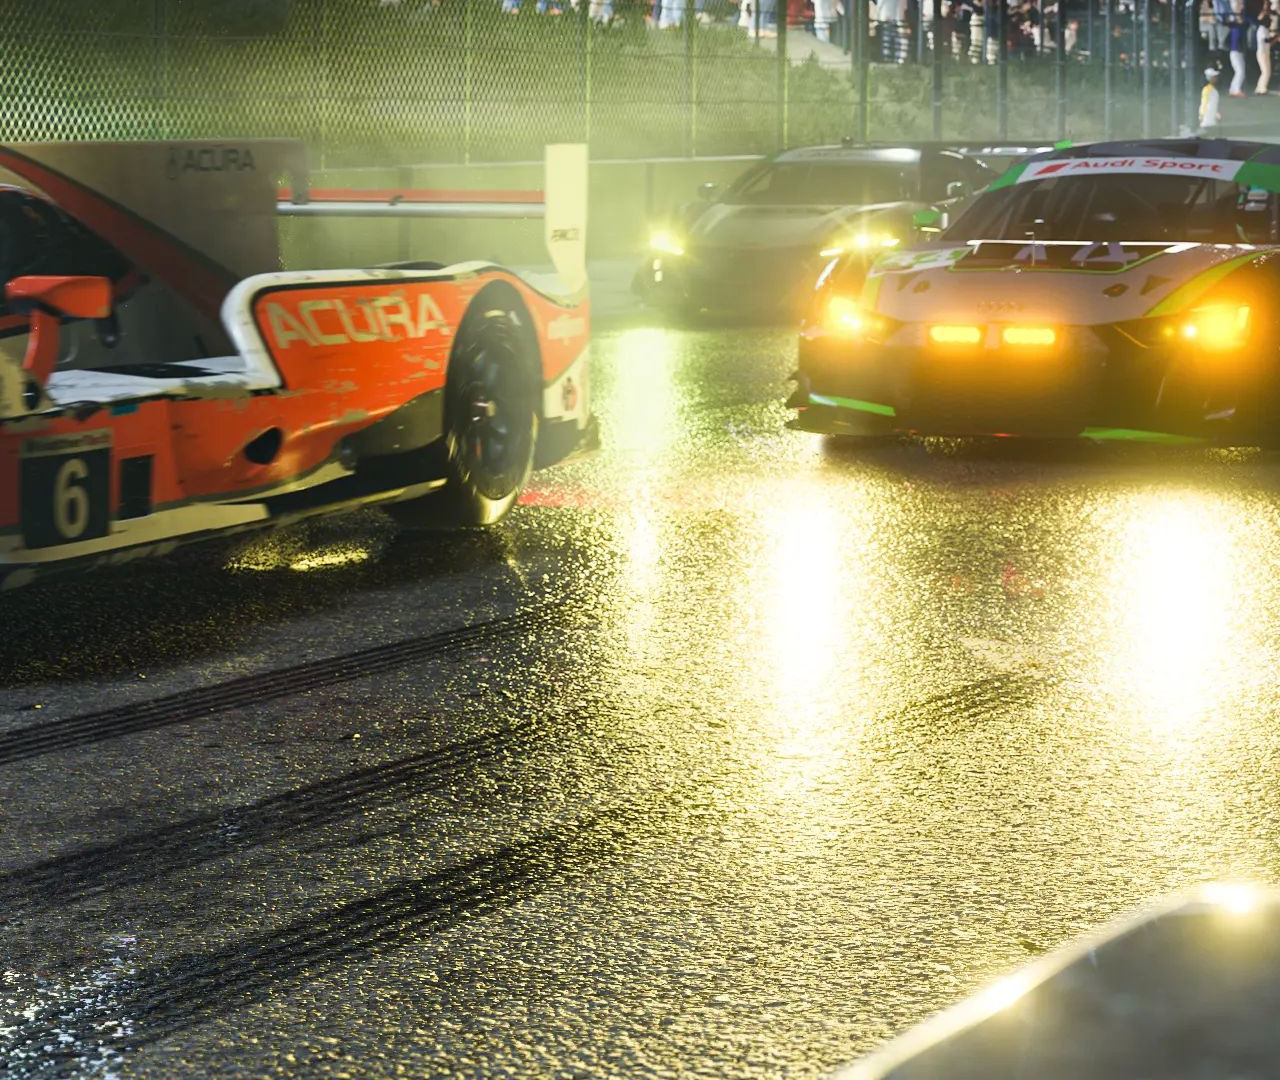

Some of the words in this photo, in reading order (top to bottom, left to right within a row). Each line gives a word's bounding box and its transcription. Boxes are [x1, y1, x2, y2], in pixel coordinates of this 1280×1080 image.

[1071, 158, 1135, 169] Audi
[1143, 159, 1225, 173] Sport
[265, 294, 455, 349] ACURA
[53, 458, 89, 539] 6
